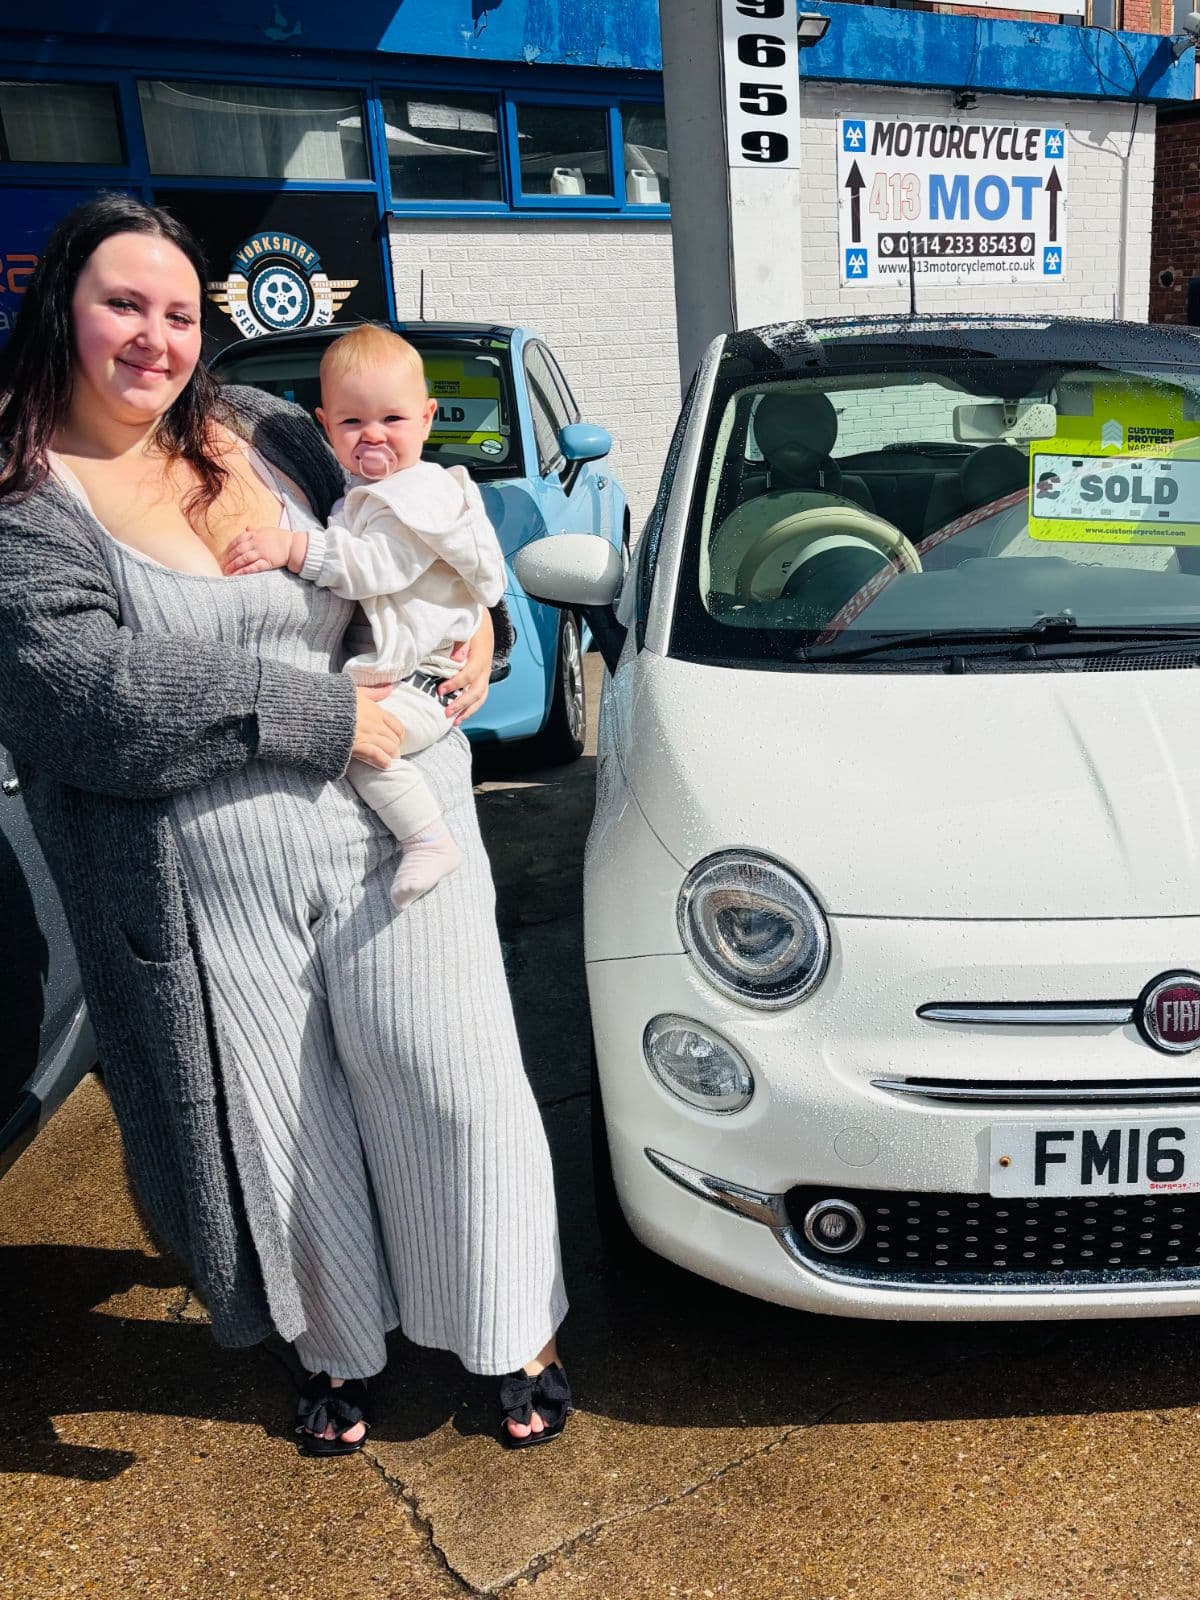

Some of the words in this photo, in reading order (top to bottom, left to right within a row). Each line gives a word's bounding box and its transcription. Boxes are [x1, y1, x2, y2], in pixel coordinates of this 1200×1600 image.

[871, 121, 1041, 161] MOTORCYCLE
[869, 172, 921, 221] 413
[929, 174, 1043, 221] MOT
[236, 236, 315, 264] YORKSHIRE
[899, 236, 941, 255] 0114
[945, 236, 974, 254] 233
[978, 235, 1017, 254] 8543
[1127, 426, 1175, 436] CUSTOMER
[1127, 435, 1175, 444] PROTECT
[1079, 474, 1179, 505] SOLD
[1085, 526, 1187, 537] www.customerprotect.com
[1162, 1000, 1200, 1032] FIAT
[1034, 1127, 1186, 1186] FM16
